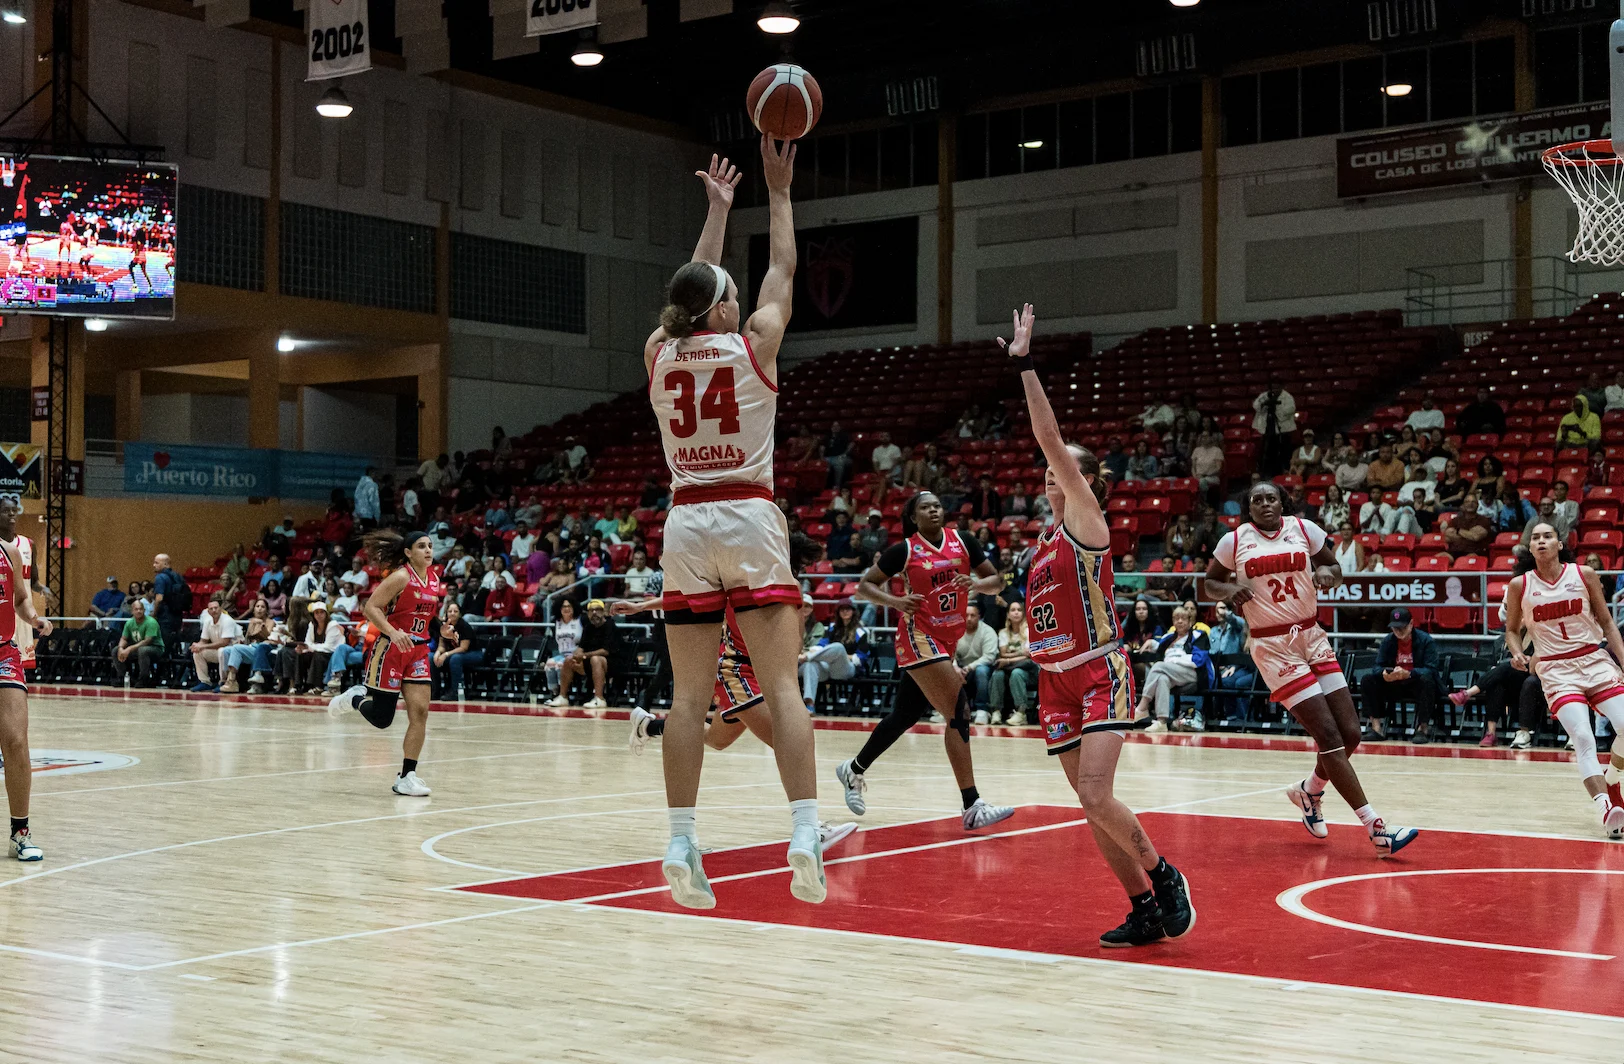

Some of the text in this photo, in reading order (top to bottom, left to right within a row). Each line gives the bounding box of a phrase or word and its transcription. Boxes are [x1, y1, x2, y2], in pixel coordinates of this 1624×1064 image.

[312, 22, 364, 62] 2002
[1350, 142, 1447, 168] COLISEO
[1455, 123, 1590, 157] GILLERMO
[1375, 165, 1416, 180] CASA
[1420, 161, 1442, 175] DE
[1446, 158, 1476, 171] LOS
[675, 348, 720, 362] BERGER
[664, 367, 740, 438] 34
[678, 444, 736, 462] MAGNA
[136, 461, 208, 487] Puerto
[212, 465, 256, 488] Rico
[1267, 577, 1300, 602] 24
[1368, 579, 1436, 601] LOPÉS
[938, 592, 958, 613] 27
[410, 617, 426, 634] 10
[1031, 602, 1058, 633] 32
[1558, 622, 1569, 640] 1
